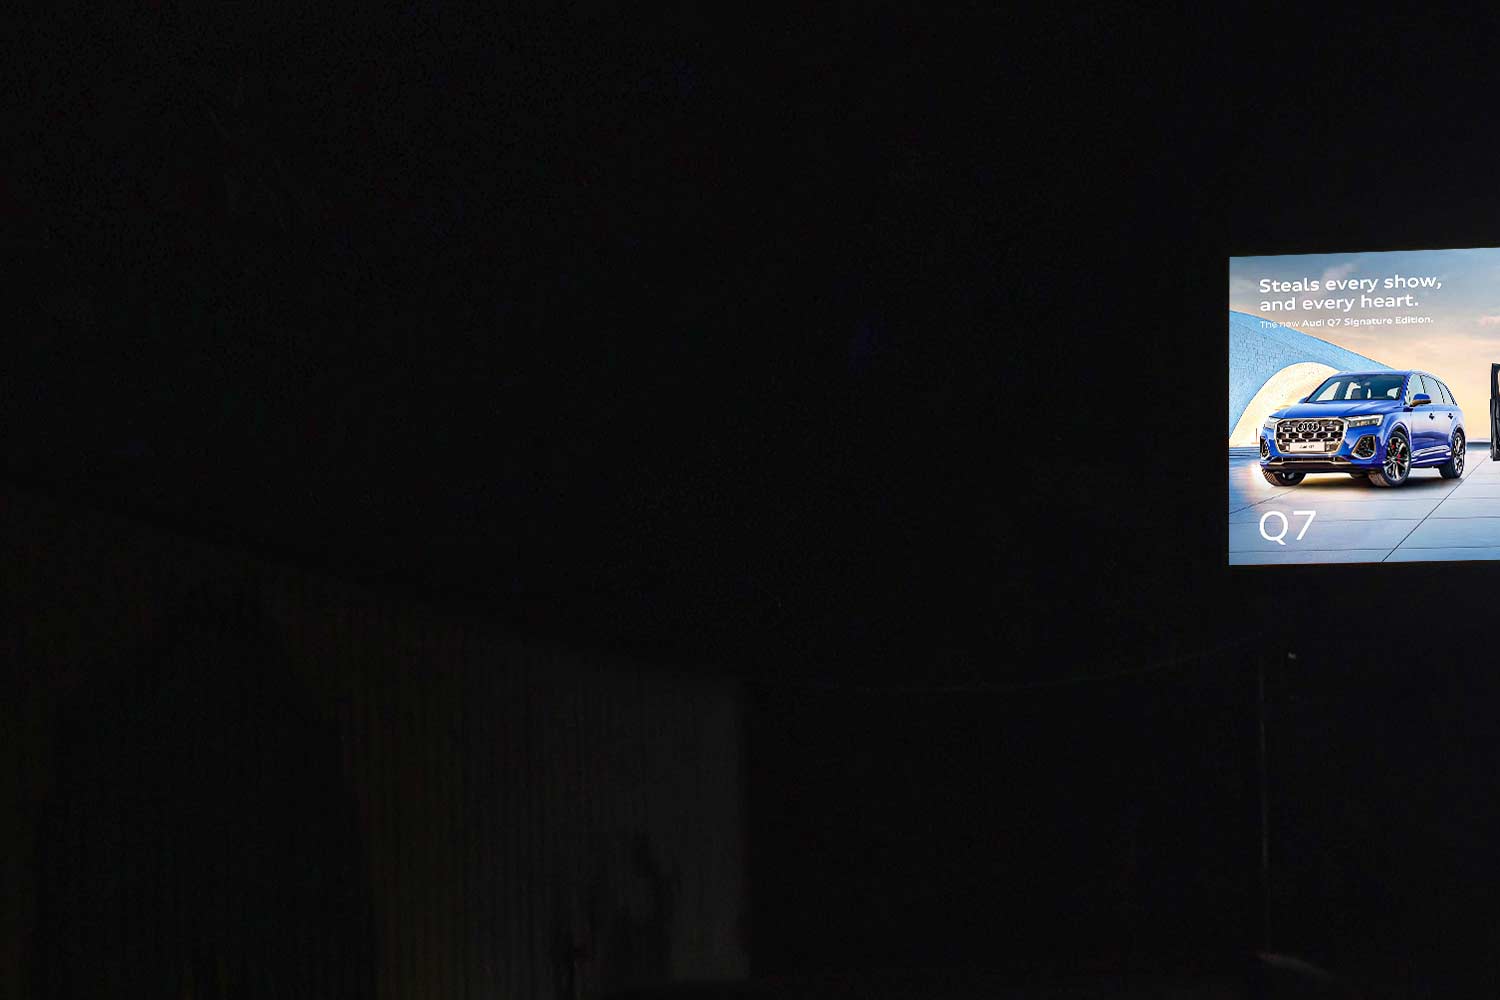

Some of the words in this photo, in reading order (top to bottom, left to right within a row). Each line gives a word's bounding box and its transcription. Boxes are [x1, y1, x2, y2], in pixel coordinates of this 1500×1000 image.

[1259, 278, 1320, 294] Steals
[1325, 278, 1379, 293] every
[1384, 275, 1442, 290] show,
[1260, 297, 1296, 312] and
[1302, 297, 1356, 312] every
[1361, 294, 1419, 308] heart.
[1260, 321, 1277, 329] The
[1302, 319, 1325, 328] Audi
[1327, 318, 1341, 328] Q7
[1344, 317, 1393, 328] Signature
[1395, 315, 1434, 325] Edition.
[1258, 511, 1317, 546] Q7
